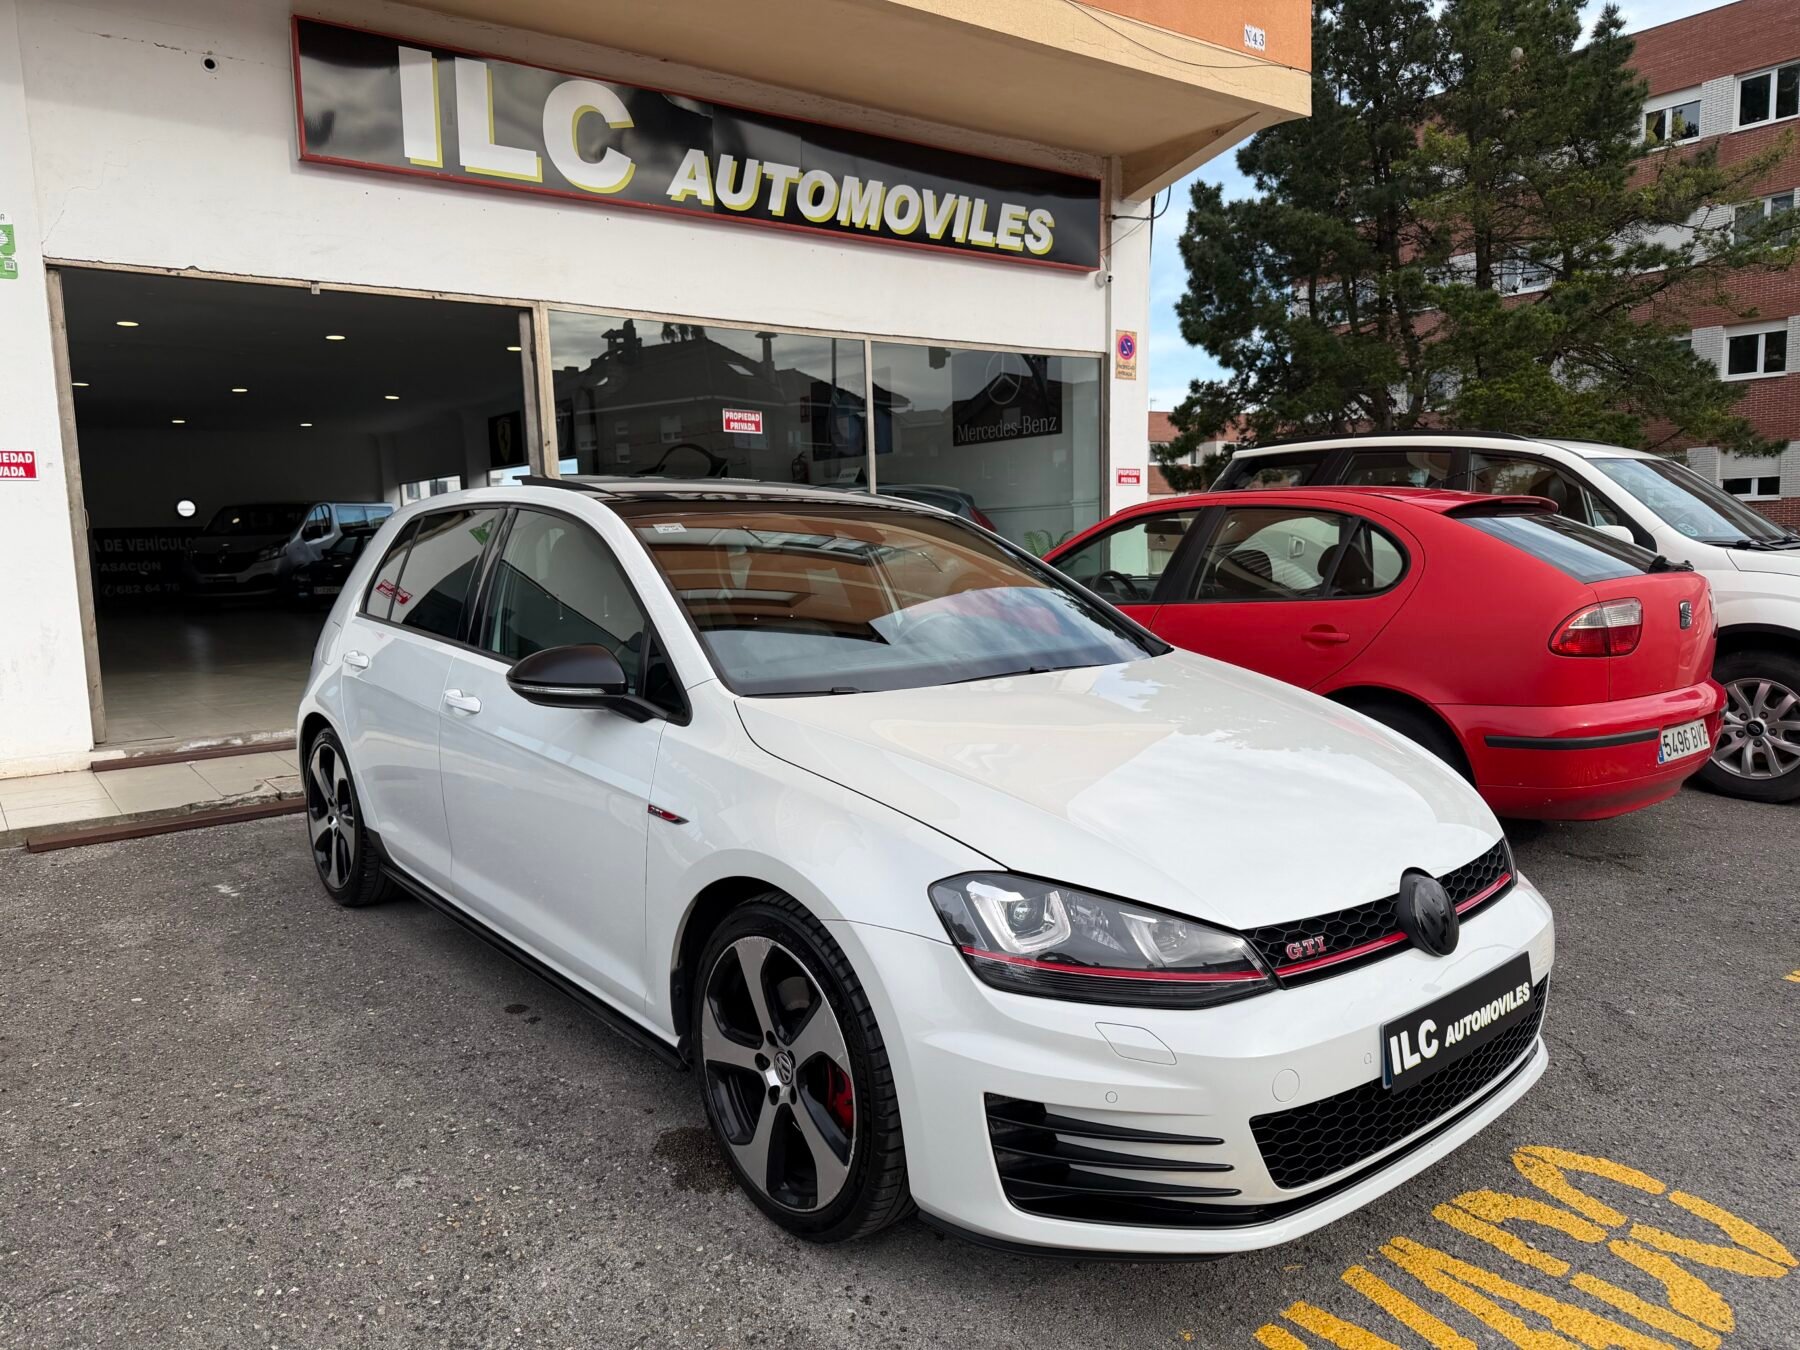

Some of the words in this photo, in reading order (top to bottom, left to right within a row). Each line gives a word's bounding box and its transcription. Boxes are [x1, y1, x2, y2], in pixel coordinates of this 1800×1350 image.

[398, 45, 636, 194] ILC
[666, 148, 1055, 255] AUTOMOVILES
[725, 411, 760, 421] PROPIEDAD
[730, 421, 756, 431] PRIVADA
[957, 416, 1057, 442] Mercedes-Benz
[104, 538, 123, 552] DE
[1663, 729, 1691, 757] 5496
[1286, 935, 1327, 960] GTI
[1390, 1019, 1439, 1075] ILC
[1445, 981, 1531, 1047] AUTOMOVILES
